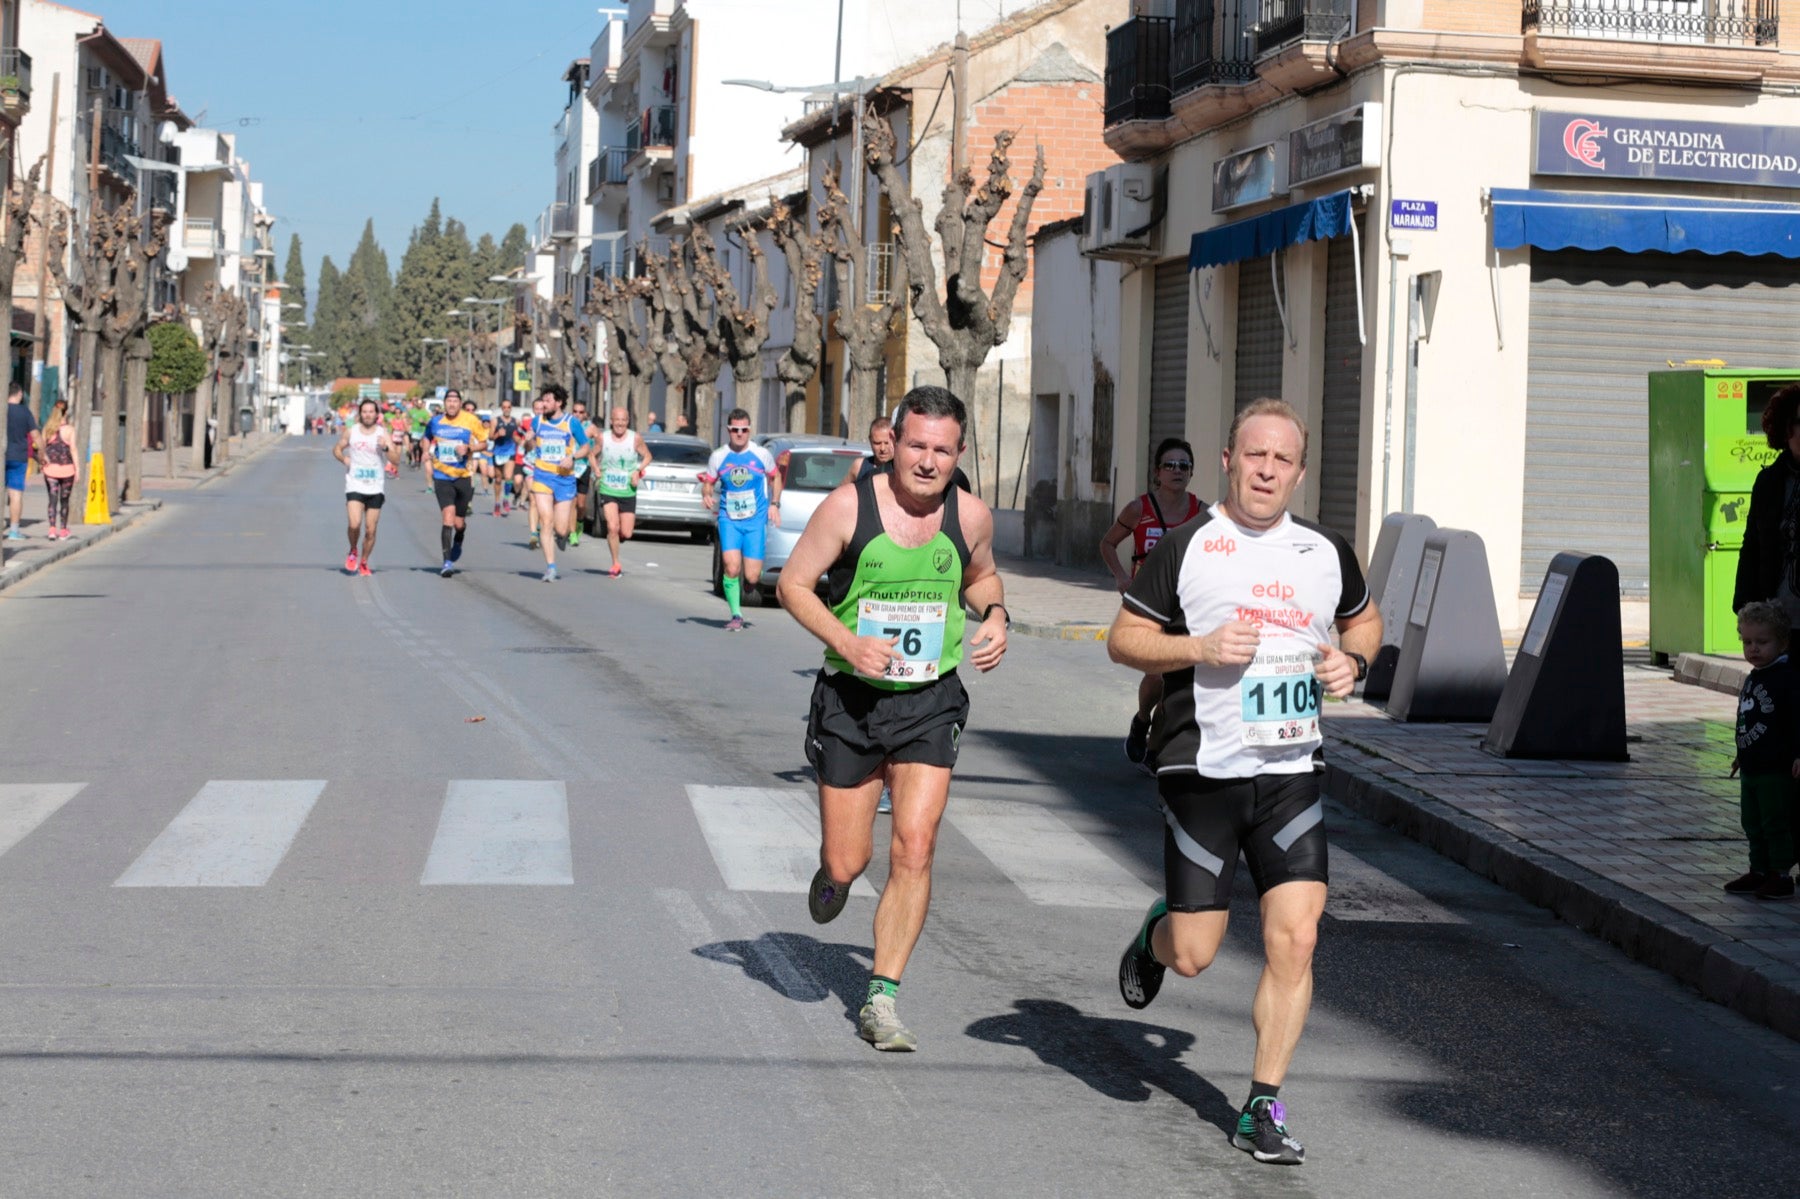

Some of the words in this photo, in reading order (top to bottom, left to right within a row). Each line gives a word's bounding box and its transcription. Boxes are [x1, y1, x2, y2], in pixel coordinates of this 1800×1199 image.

[1613, 128, 1725, 150] GRANADINA
[1627, 147, 1654, 164] DE
[1401, 201, 1426, 211] PLAZA
[1393, 213, 1435, 228] NARANJOS
[545, 445, 561, 455] 493
[90, 479, 96, 502] 9
[734, 501, 748, 511] 84
[1203, 535, 1237, 556] edp
[865, 559, 883, 569] vive
[1252, 580, 1295, 601] edp
[881, 604, 896, 613] GRAN
[897, 604, 917, 613] PREMIO
[882, 627, 922, 656] 76
[1266, 655, 1284, 665] GRAN
[1248, 680, 1318, 716] 1105
